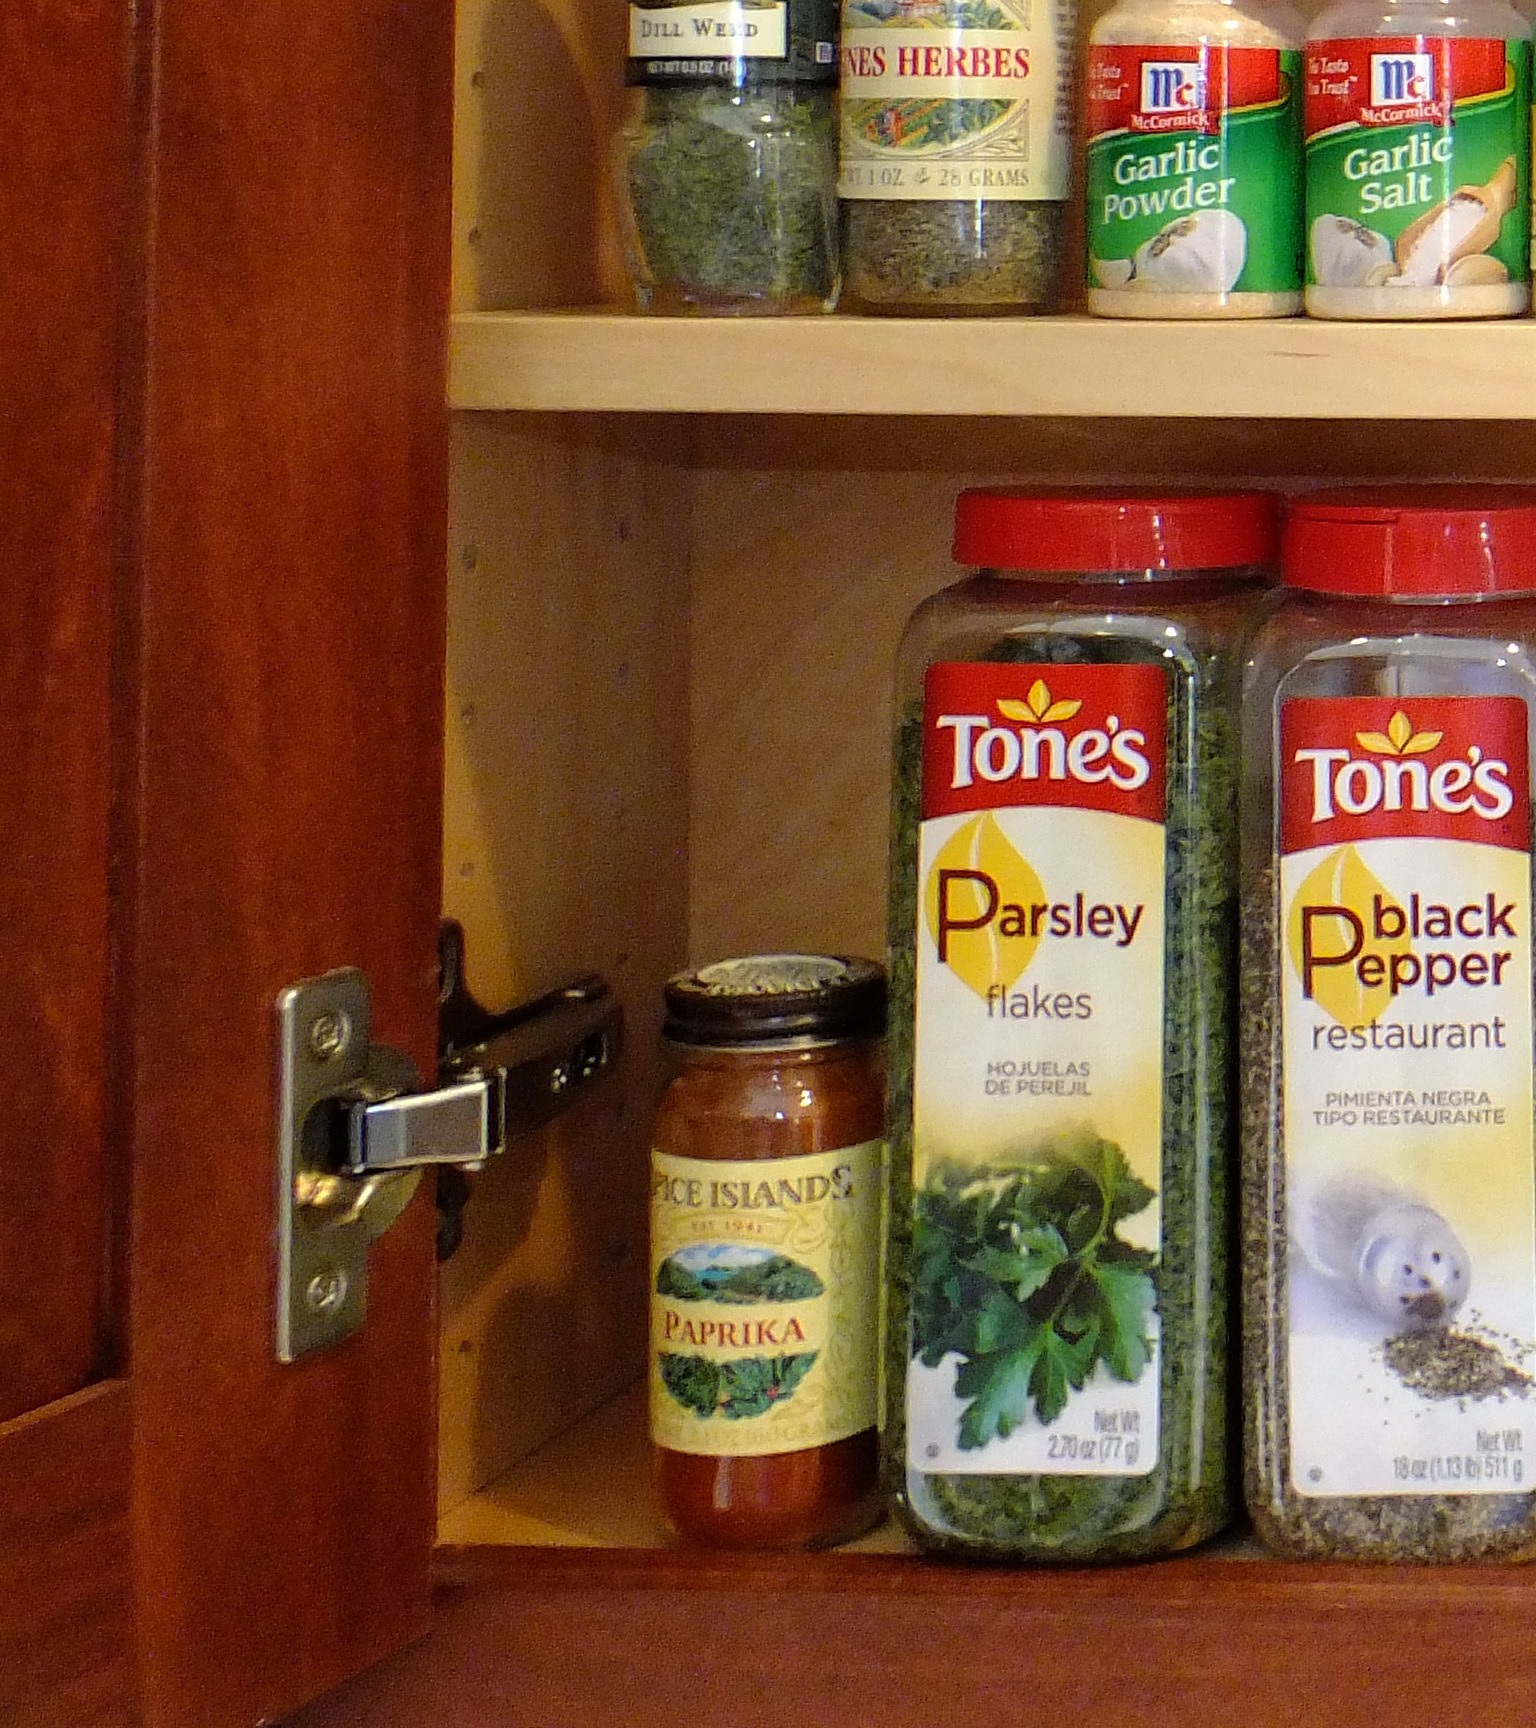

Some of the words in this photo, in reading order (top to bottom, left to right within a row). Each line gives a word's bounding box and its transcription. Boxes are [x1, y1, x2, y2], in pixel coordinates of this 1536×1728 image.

[896, 46, 1030, 79] HERBES
[1113, 140, 1220, 185] Garlic
[1343, 131, 1454, 180] Garlic
[969, 168, 1030, 187] GRAMS
[1359, 173, 1433, 214] Salt
[1102, 175, 1236, 225] Powder
[936, 714, 1151, 790] Tone's
[1295, 745, 1514, 825] Tone's
[937, 868, 1145, 963] Parsley
[1373, 893, 1518, 939] black
[1301, 905, 1513, 1000] Pepper
[986, 984, 1092, 1020] flakes
[1313, 1015, 1507, 1052] restaurant
[987, 1061, 1091, 1077] HOJUELAS
[1313, 1109, 1358, 1125] TIPO
[1363, 1109, 1506, 1126] RESTAURANTE
[1325, 1090, 1415, 1107] PIMIENTA
[1422, 1091, 1492, 1107] NEGRA
[664, 1311, 805, 1348] PAPRIKA
